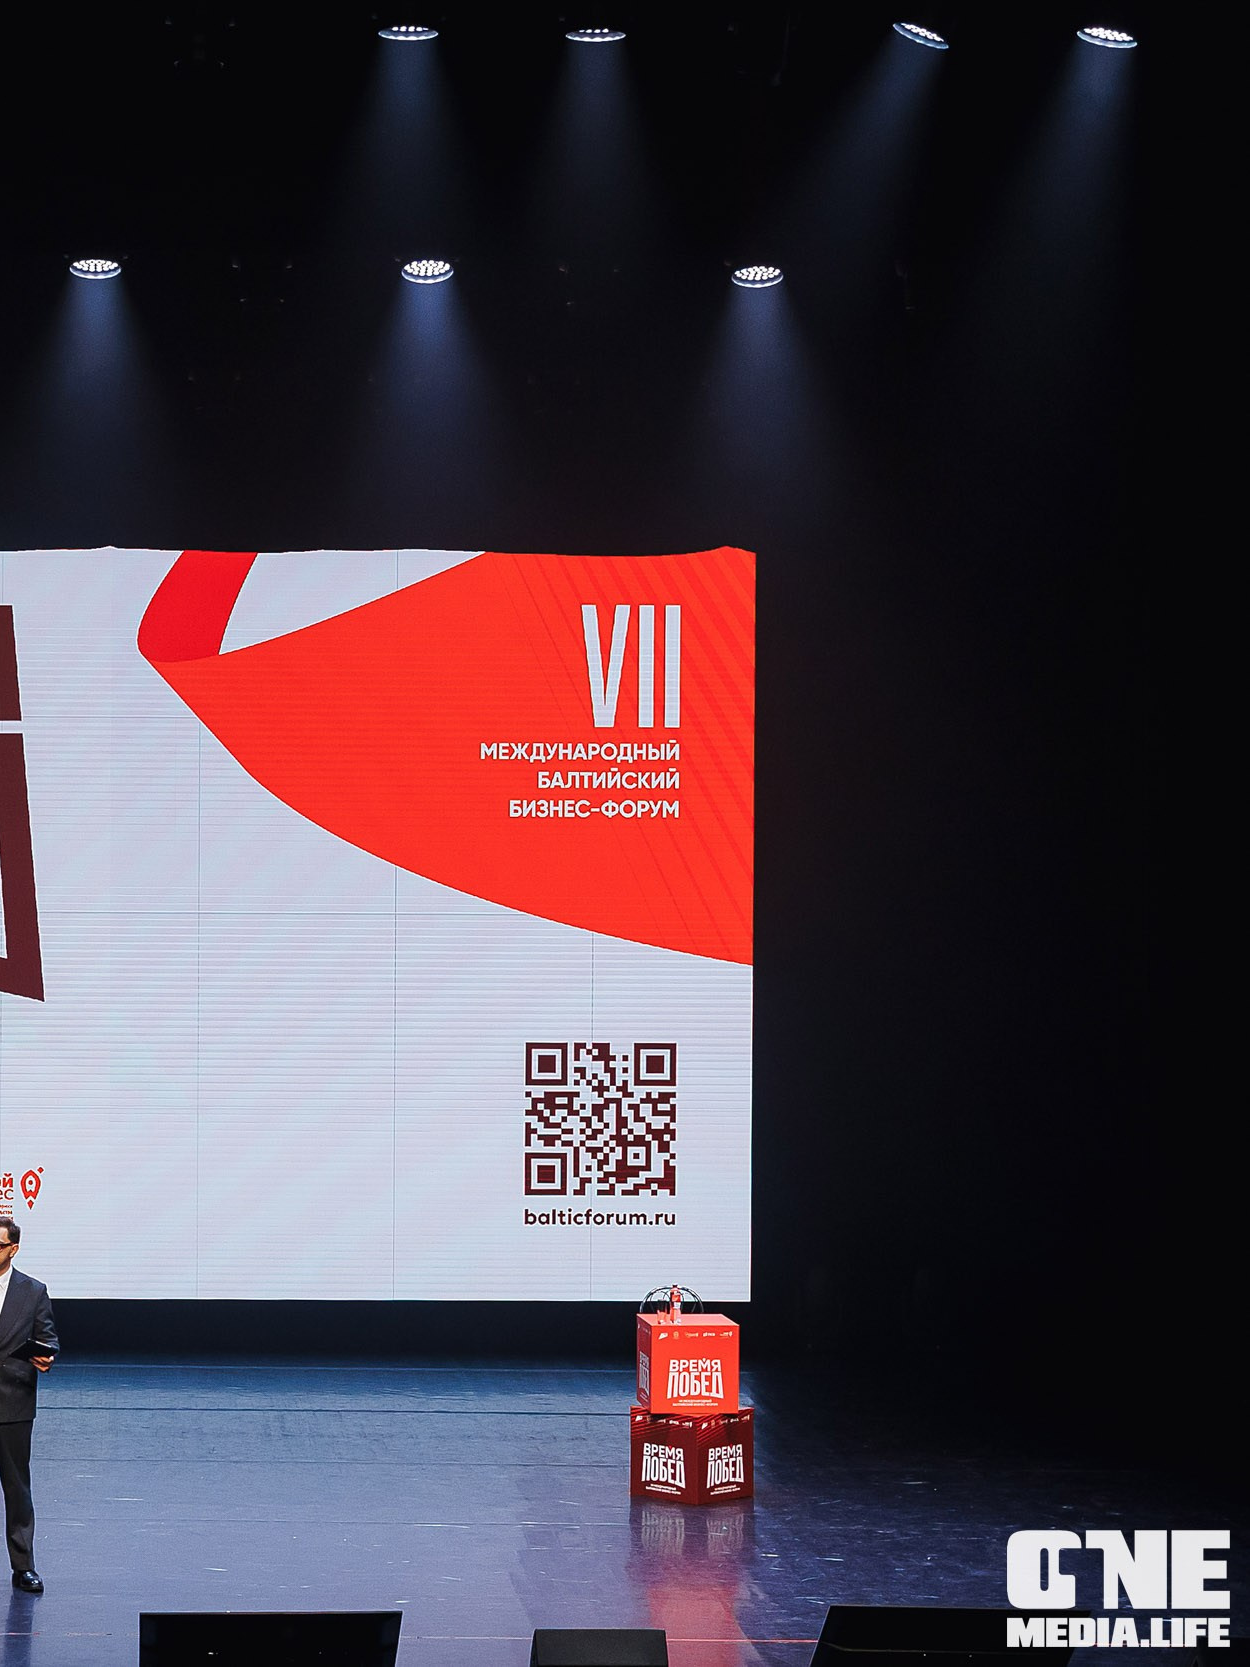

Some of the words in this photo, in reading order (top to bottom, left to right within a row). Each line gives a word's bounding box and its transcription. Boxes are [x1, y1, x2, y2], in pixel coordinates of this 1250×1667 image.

[581, 604, 681, 728] VII
[479, 739, 680, 763] МЕЖДУНАРОДНЫЙ
[537, 767, 680, 789] БАЛТИЙСКИЙ
[509, 799, 680, 818] БИЗНЕС-ФОРУМ
[524, 1208, 676, 1226] balticforum.ru
[669, 1359, 721, 1372] ВРЕМЯ
[667, 1372, 724, 1399] ПОБЕД
[643, 1443, 684, 1461] ВРЕМЯ
[708, 1444, 743, 1461] ВРЕМЯ
[641, 1455, 686, 1489] ПОБЕД
[707, 1456, 744, 1488] ПОБЕД
